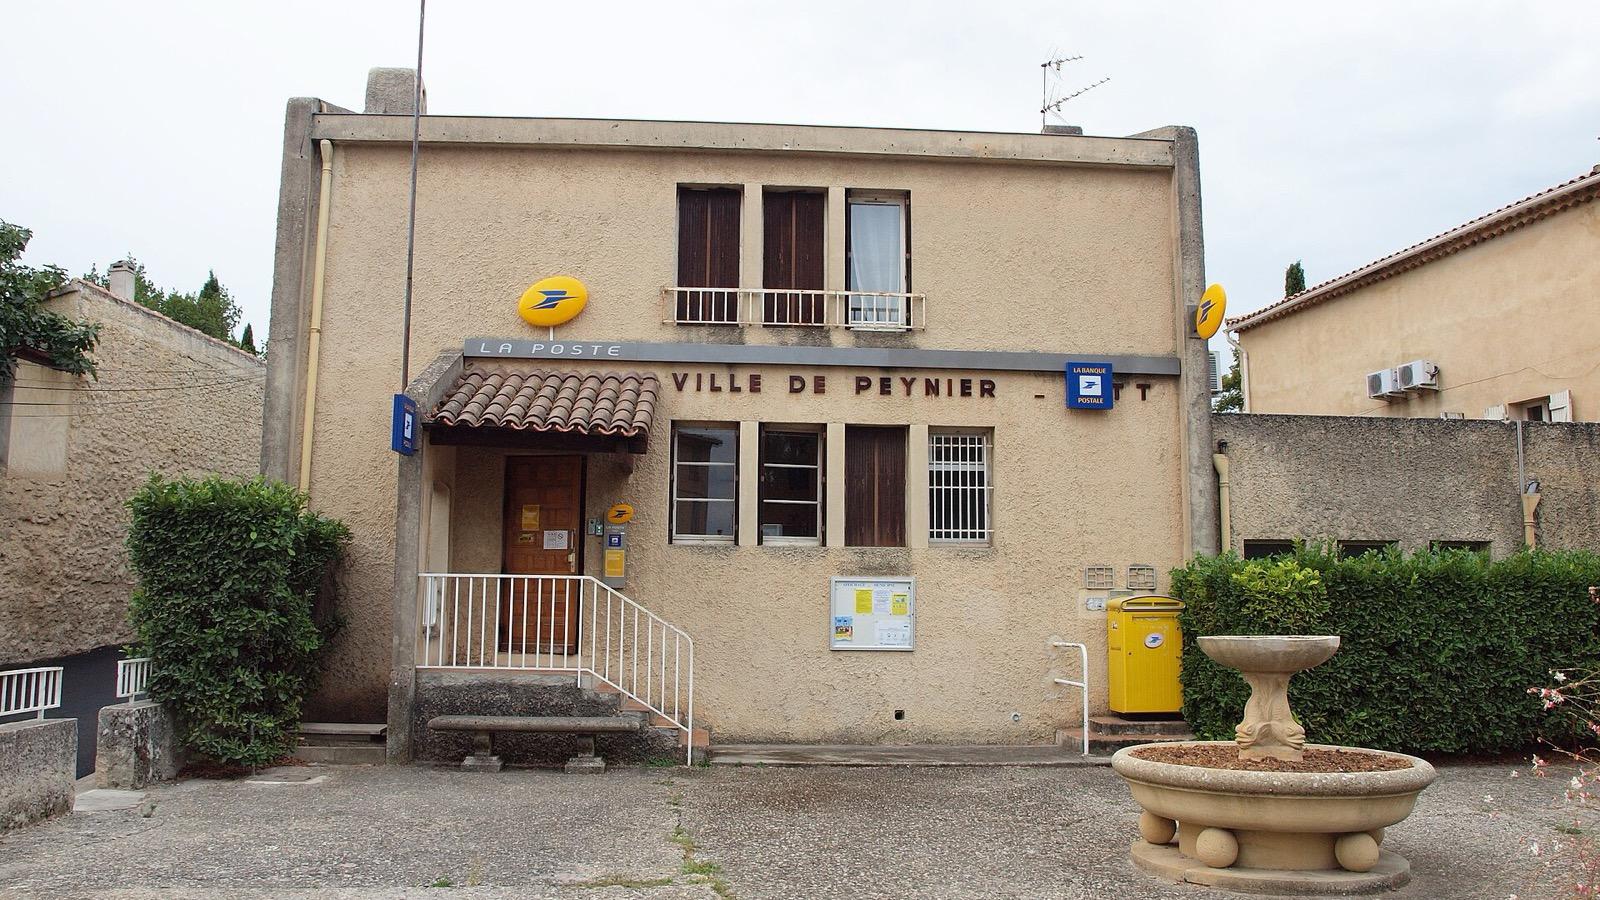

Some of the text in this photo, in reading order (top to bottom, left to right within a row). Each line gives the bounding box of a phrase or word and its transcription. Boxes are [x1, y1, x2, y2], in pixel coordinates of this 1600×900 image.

[480, 343, 621, 357] LA POSTE
[672, 373, 761, 393] VILLE
[789, 375, 826, 394] DE
[855, 376, 996, 398] PEYNIER
